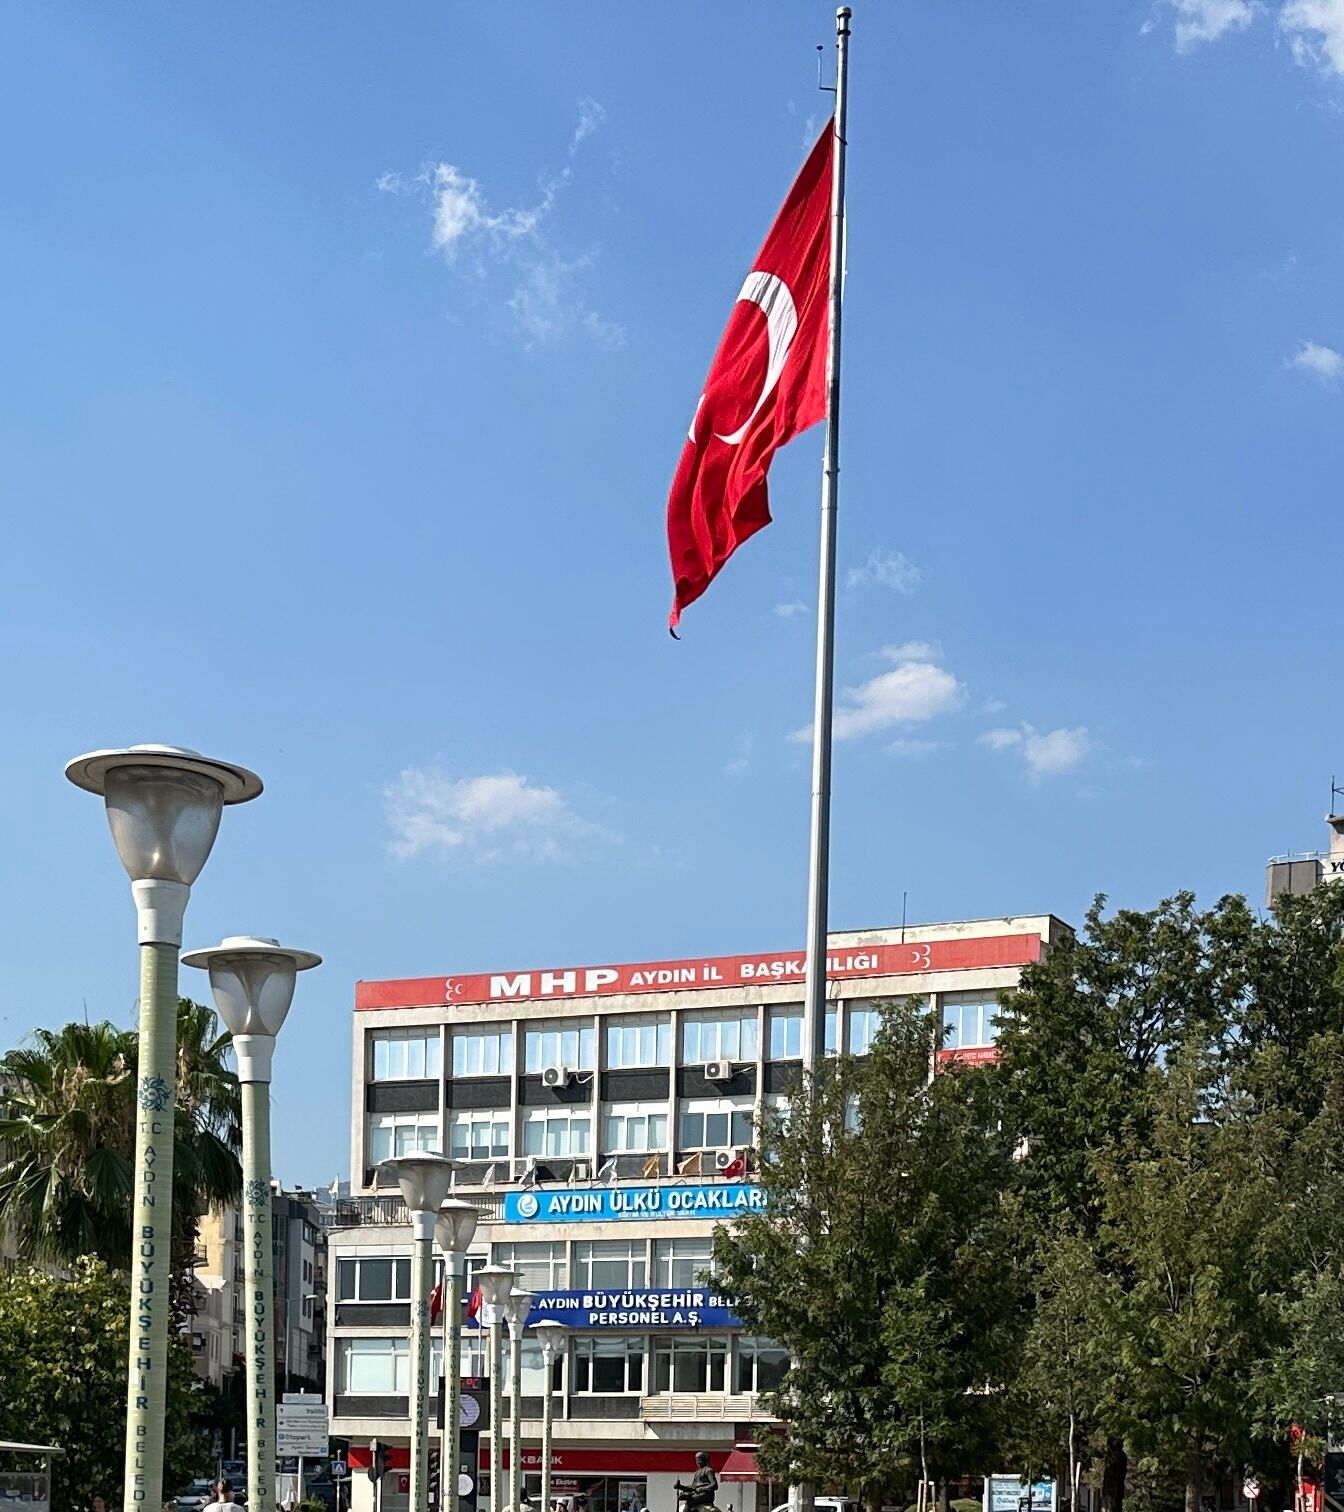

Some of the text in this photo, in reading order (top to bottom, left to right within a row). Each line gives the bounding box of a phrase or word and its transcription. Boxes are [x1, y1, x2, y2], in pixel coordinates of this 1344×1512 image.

[489, 951, 878, 998] MHP AYDIN İL BAŞKLIĞI
[143, 1146, 156, 1207] AYDIN
[548, 1194, 602, 1213] AYDIN
[610, 1189, 660, 1211] ÜLKÜ
[539, 1298, 579, 1309] AYDIN
[583, 1290, 704, 1311] BÜYÜKŞEHİR
[590, 1311, 702, 1326] PERSONEL A.Ş.
